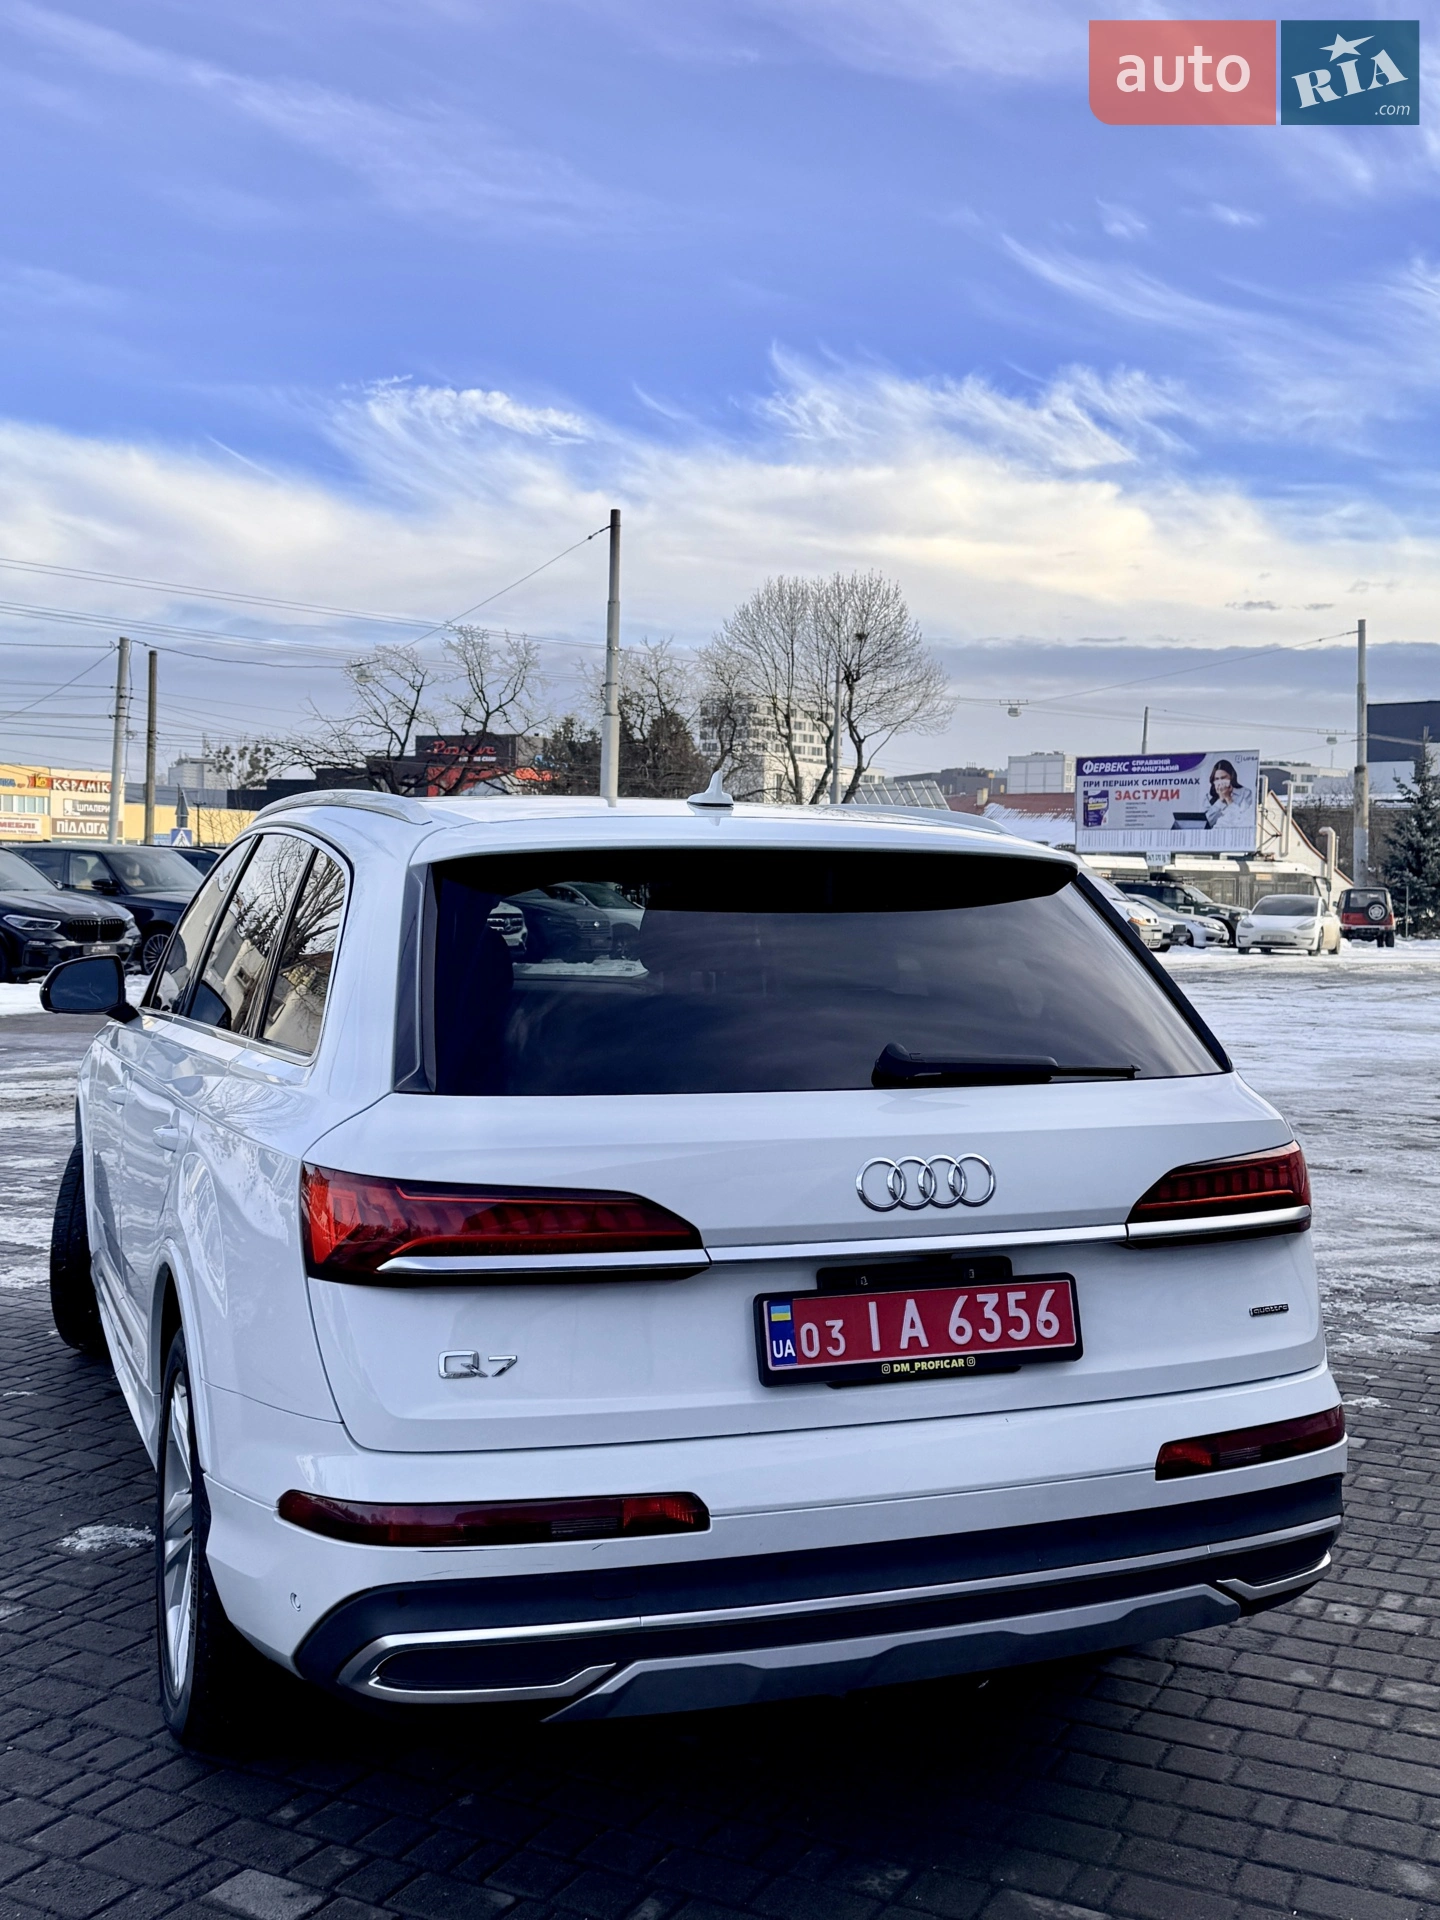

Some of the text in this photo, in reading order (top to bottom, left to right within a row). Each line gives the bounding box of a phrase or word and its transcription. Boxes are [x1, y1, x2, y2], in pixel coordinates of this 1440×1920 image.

[1082, 760, 1130, 775] ФЕРВЕКС
[1131, 764, 1180, 773] ФРАНЦУЗЬКИЙ
[1083, 778, 1200, 788] ПРИ ПЕРШИХ СИМПТОМАХ
[1115, 789, 1180, 801] ЗАСТУДИ
[773, 1289, 1060, 1358] UA 03 IA 6356
[438, 1350, 517, 1379] Q7
[893, 1359, 965, 1373] DM_PROFICAR
